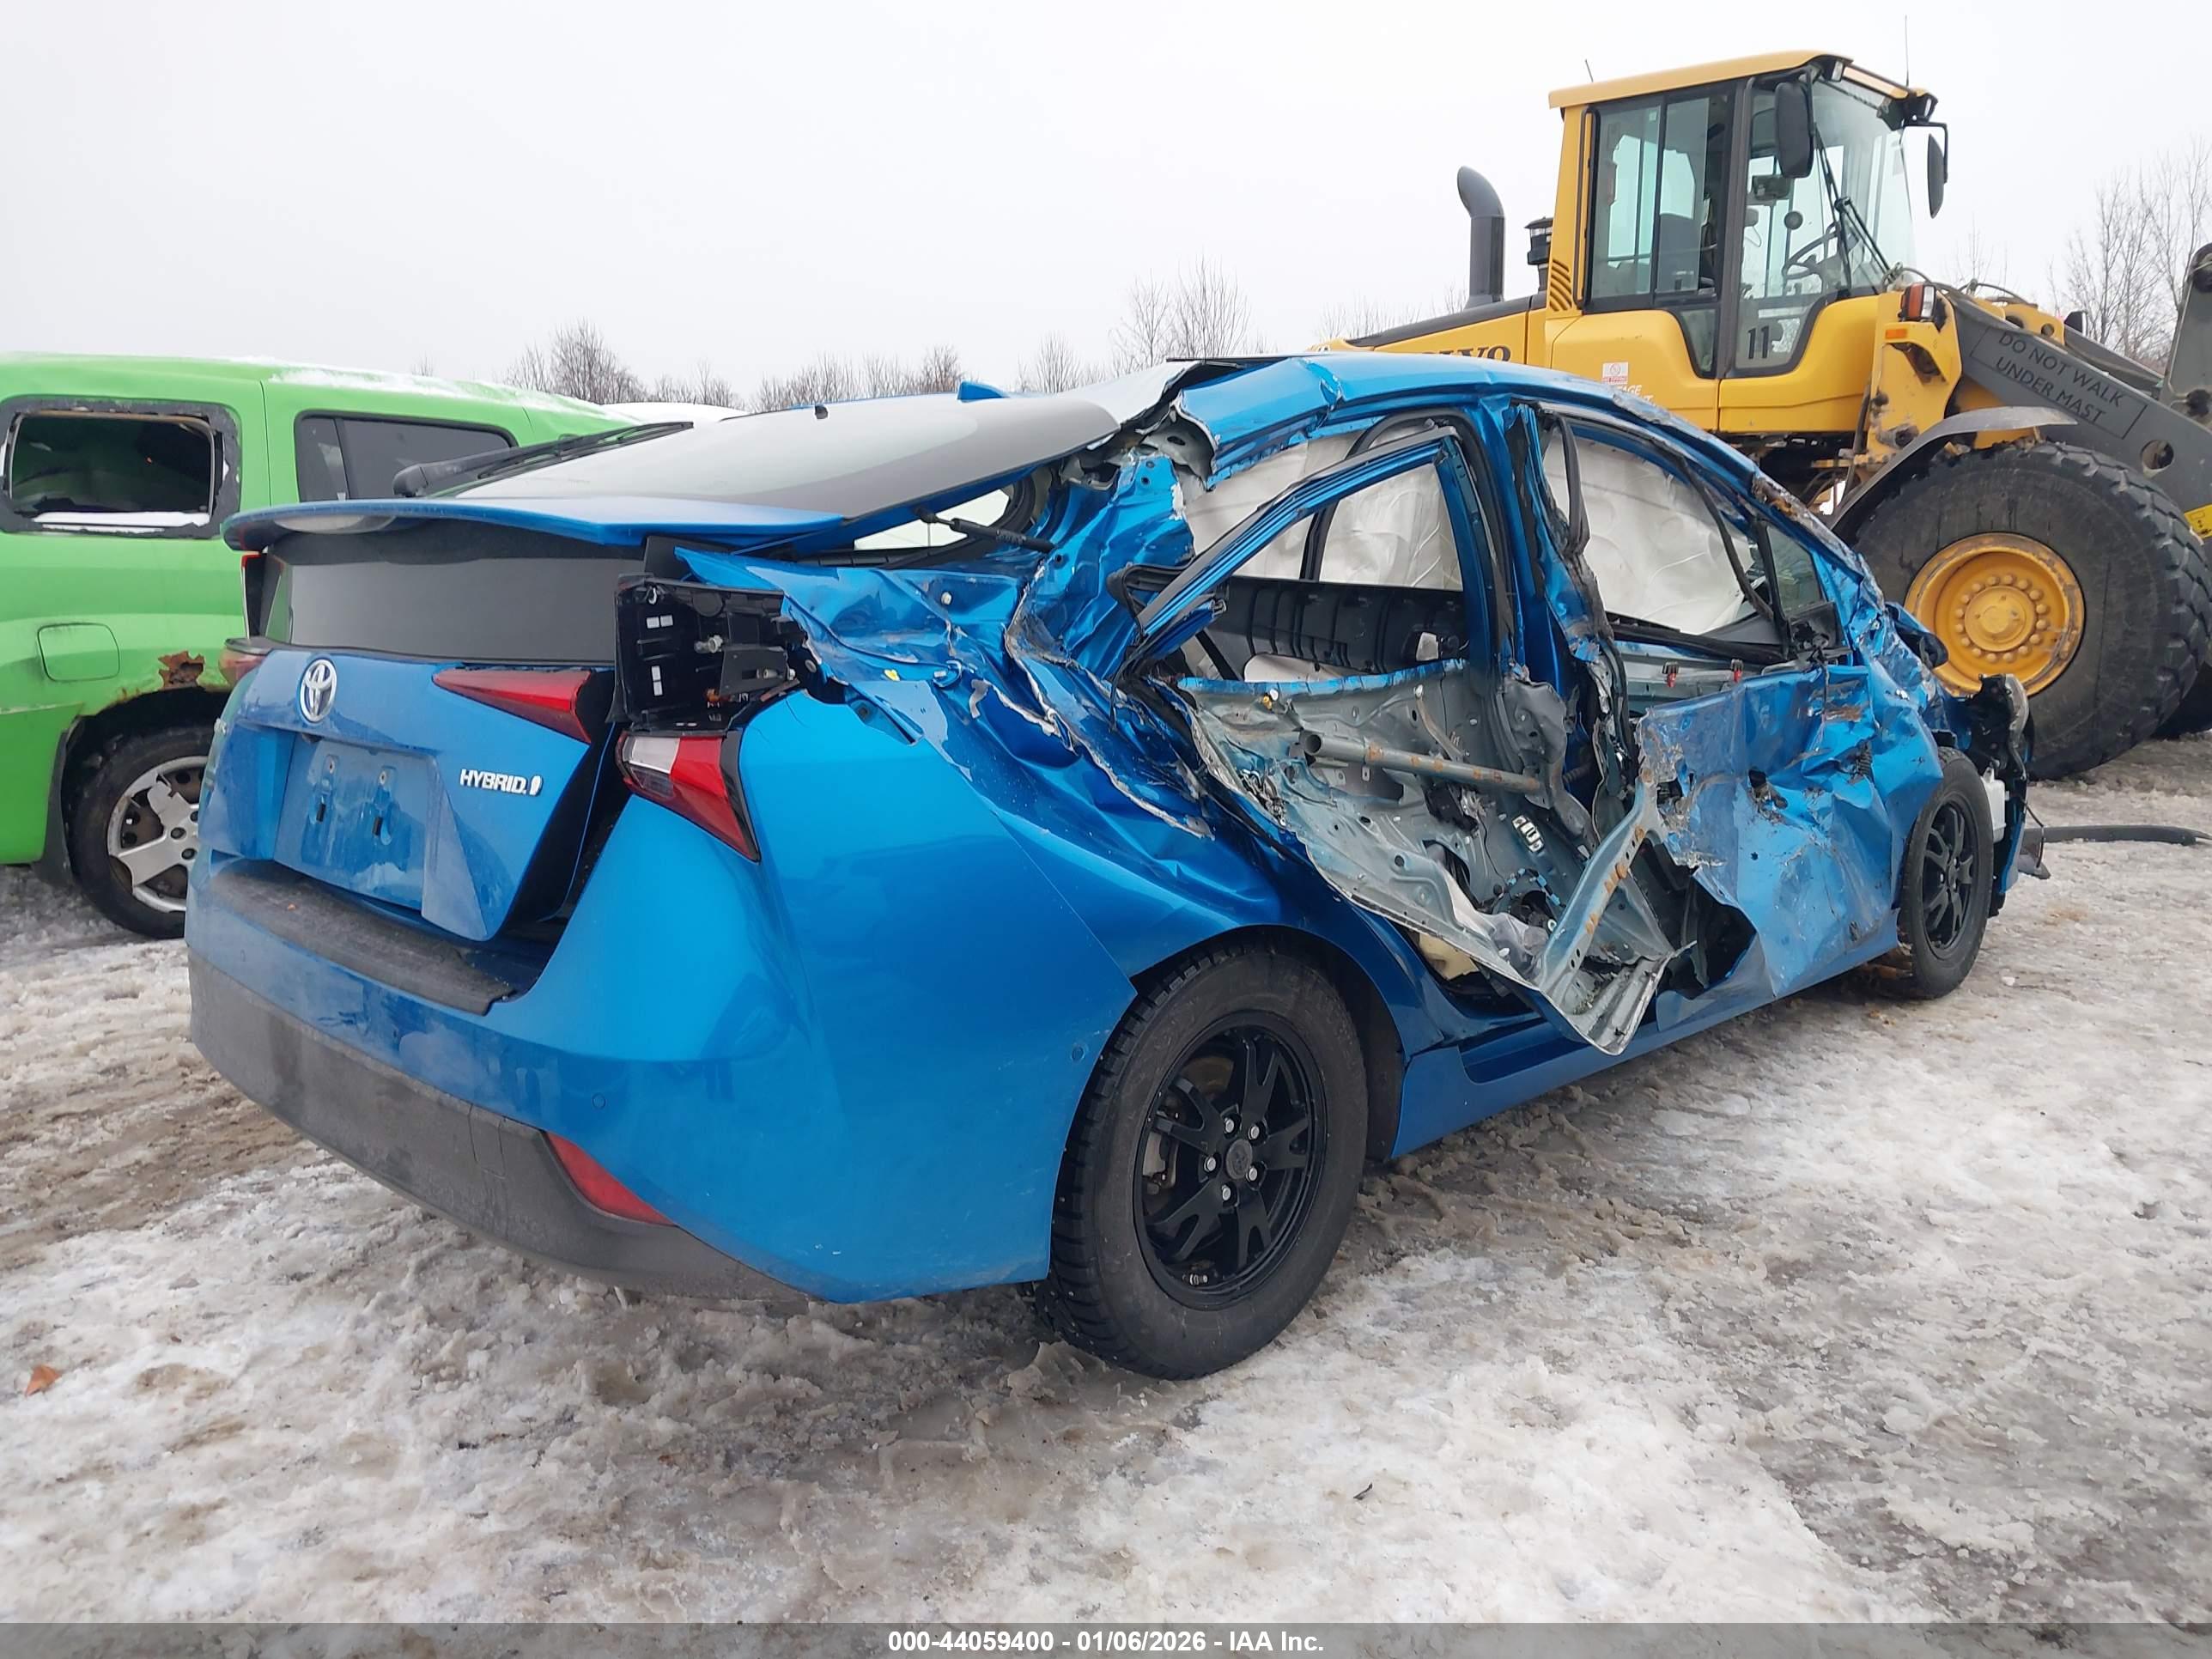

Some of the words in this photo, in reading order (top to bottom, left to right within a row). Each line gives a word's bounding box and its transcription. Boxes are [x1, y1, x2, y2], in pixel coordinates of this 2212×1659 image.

[1747, 326, 1770, 359] 11
[1998, 331, 2027, 354] DO
[2028, 347, 2068, 375] NOT
[2073, 369, 2124, 407] WALK
[1996, 356, 2055, 396] UNDER
[2056, 391, 2106, 422] MAST
